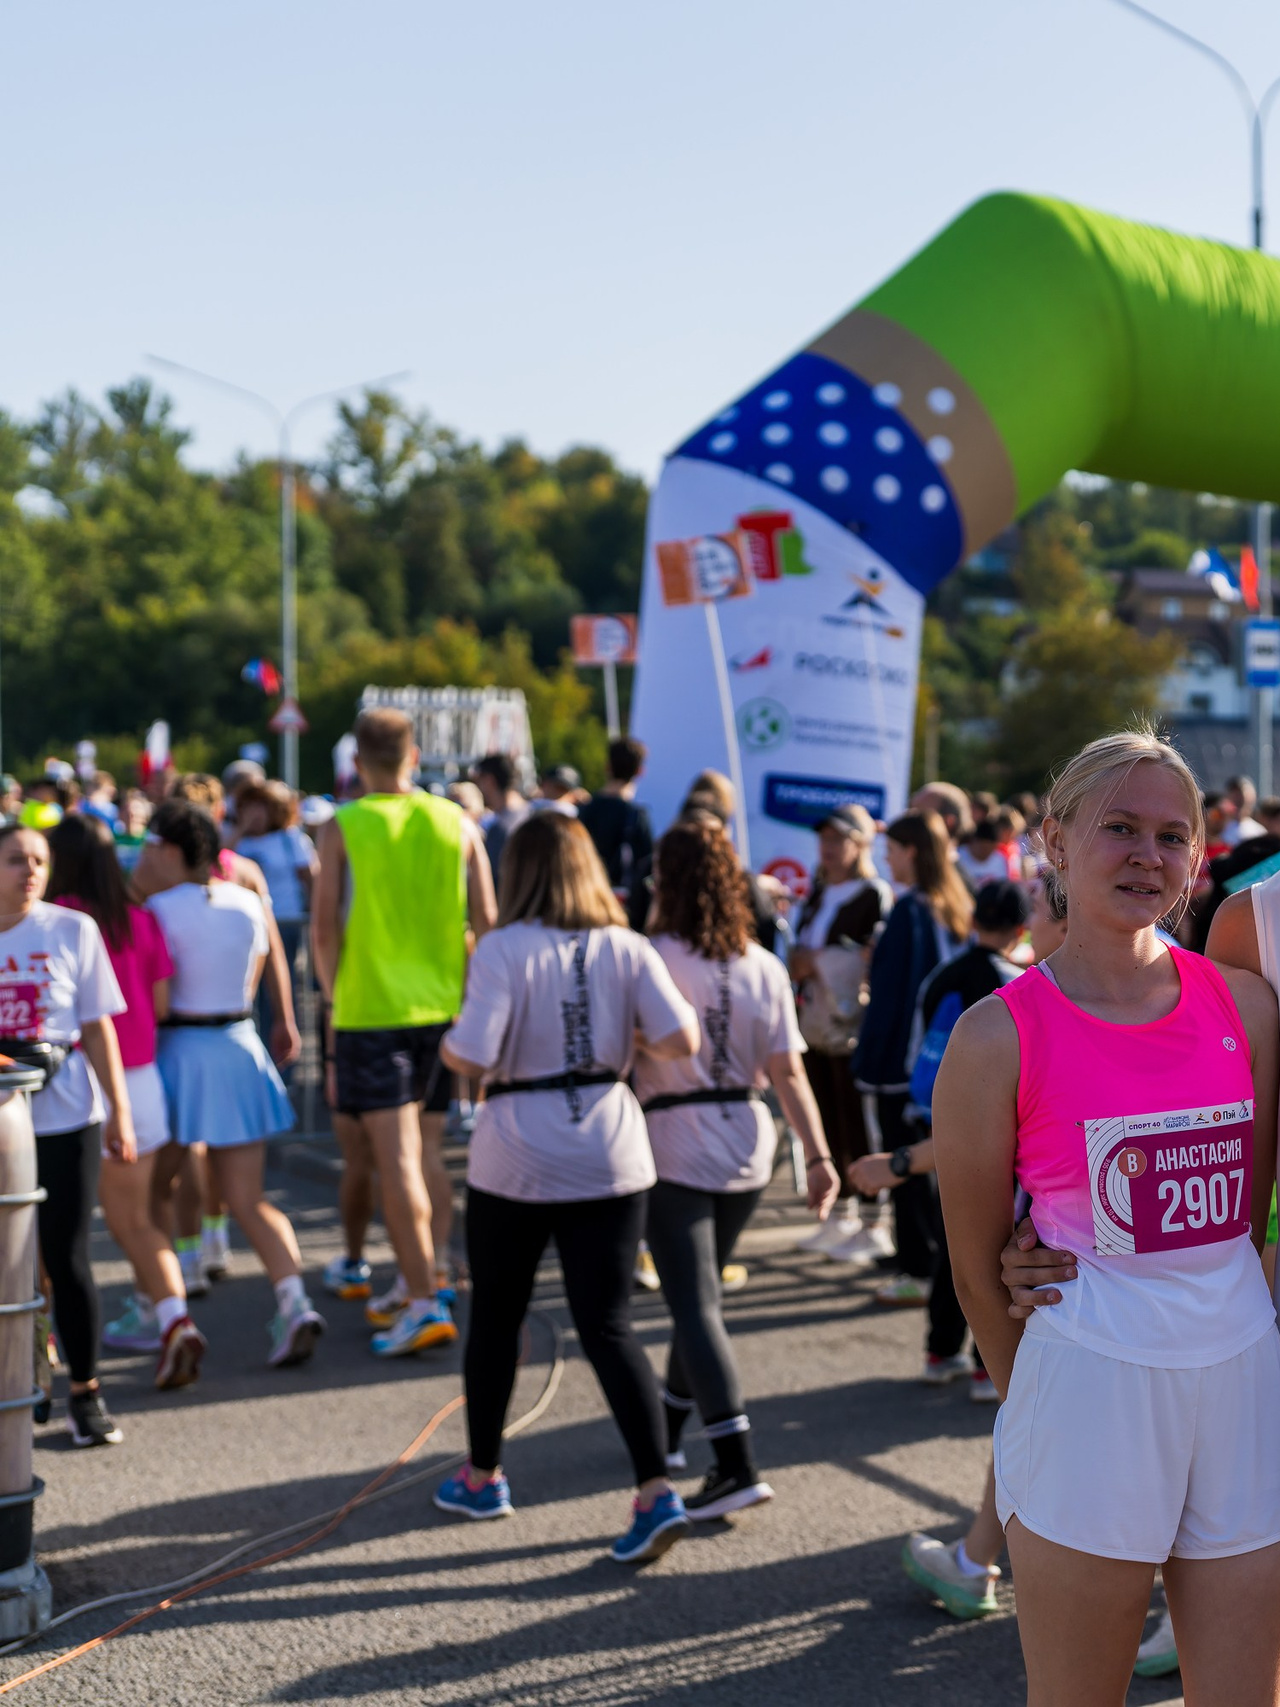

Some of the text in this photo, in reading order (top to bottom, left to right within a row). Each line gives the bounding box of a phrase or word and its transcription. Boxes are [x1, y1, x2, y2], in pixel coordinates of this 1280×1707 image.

[1223, 1110, 1235, 1120] Пэй
[1155, 1138, 1242, 1172] АНАСТАСИЯ
[1158, 1168, 1244, 1233] 2907
